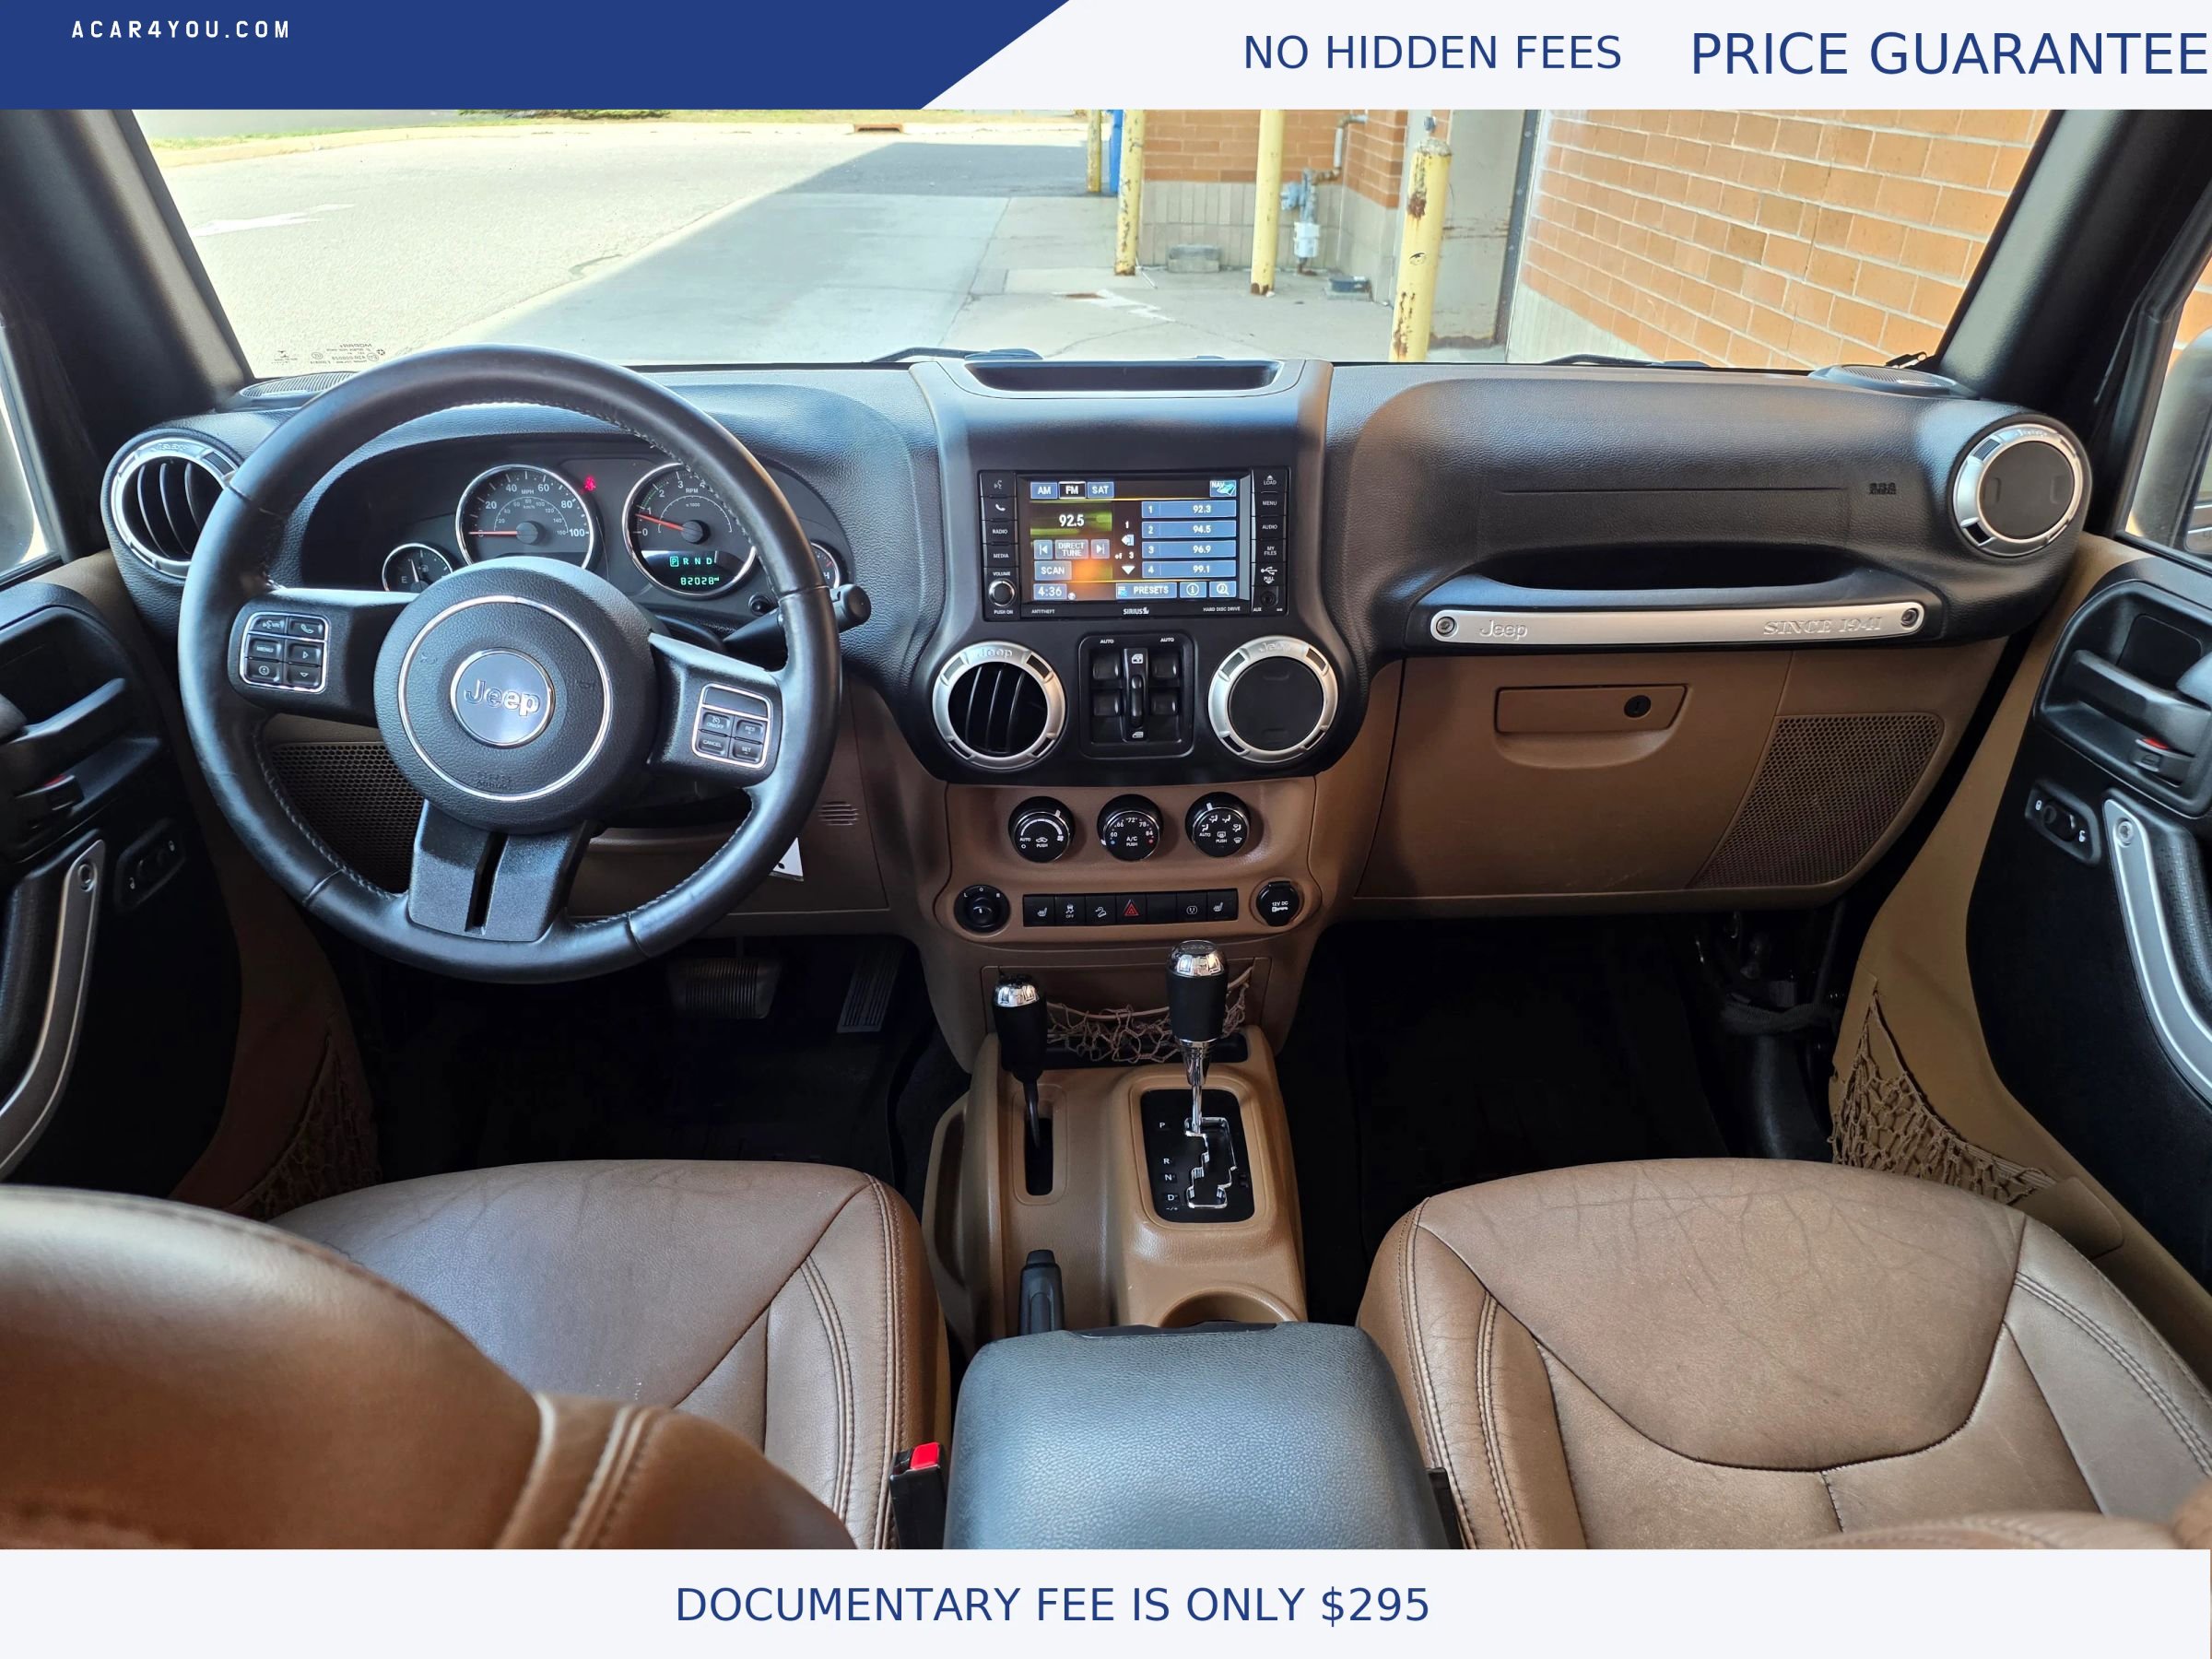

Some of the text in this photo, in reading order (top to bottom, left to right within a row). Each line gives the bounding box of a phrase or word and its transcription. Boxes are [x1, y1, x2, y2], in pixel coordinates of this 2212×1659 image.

[505, 483, 518, 493] 40
[537, 483, 550, 492] 60
[677, 480, 684, 488] 3
[1037, 486, 1052, 495] AM
[1065, 486, 1079, 495] FM
[1091, 486, 1110, 495] SAT
[485, 500, 498, 510] 20
[560, 500, 573, 509] 80
[1193, 504, 1212, 514] 92.3
[1059, 513, 1085, 527] 92.5
[569, 528, 585, 537] 100
[642, 528, 649, 536] 0
[1147, 524, 1212, 535] 2 94.5
[1147, 545, 1212, 554] 3 96.9
[1129, 551, 1135, 559] 3
[682, 557, 689, 565] R
[694, 557, 701, 565] N
[706, 557, 712, 565] D
[1041, 566, 1065, 575] SCAN
[1147, 564, 1211, 573] 4 99.1
[401, 575, 407, 583] E
[680, 576, 714, 585] 82028
[1038, 586, 1063, 597] 4:36
[1133, 585, 1170, 595] PRESETS
[1478, 619, 1528, 641] Jeep
[1763, 617, 1883, 635] SINCE 1941
[464, 679, 541, 717] Jeep
